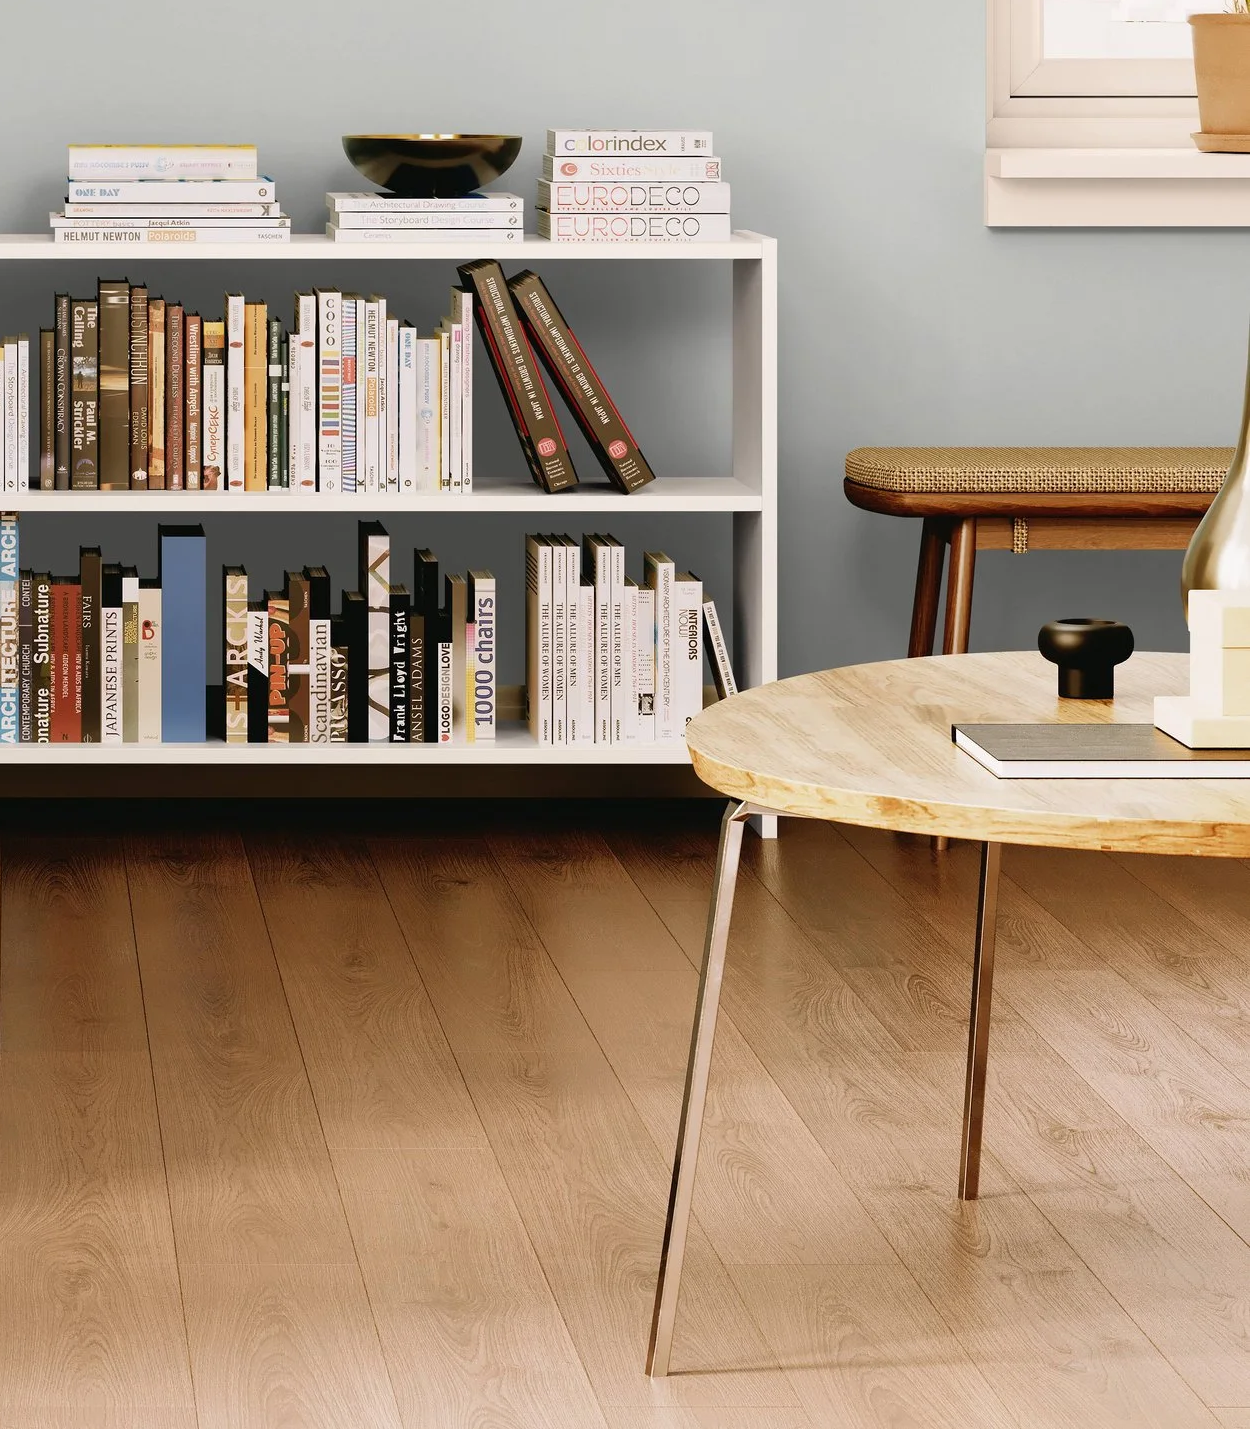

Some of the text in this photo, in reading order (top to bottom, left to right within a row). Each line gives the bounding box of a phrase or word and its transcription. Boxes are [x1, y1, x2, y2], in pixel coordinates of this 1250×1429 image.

[564, 136, 667, 152] colorindex
[590, 163, 641, 176] Sixties
[99, 189, 121, 197] DAY
[369, 201, 456, 211] Architectural Drawing
[557, 187, 700, 206] EURODECO
[63, 232, 141, 242] HELMUT NEWTON
[148, 230, 196, 241] Polaroids
[379, 216, 430, 227] Storyboard
[557, 217, 700, 237] EURODECO
[72, 306, 84, 348] Calling
[368, 309, 376, 372] HELMUT NEWTON
[485, 276, 544, 421] STRUCTURAL IMPEDIMENTS TO GROWTH IN JAPAN
[187, 323, 198, 416] Wrestling with Angels
[529, 291, 611, 426] STRUCTURAL IMPEDIMENTS TO GROWTH IN JAPAN
[6, 376, 15, 417] Storyboard
[56, 348, 65, 433] CROWN CONSPIRACY
[368, 377, 377, 417] Polaroids
[74, 400, 84, 451] Strickler
[87, 401, 96, 444] Paul M.
[33, 584, 50, 664] Subnature
[83, 595, 92, 629] FAIRS
[678, 608, 689, 638] NOW!
[254, 615, 264, 669] Andy Warhol
[556, 602, 564, 701] THE ALLURE OF WOMEN
[600, 602, 608, 701] THE ALLURE OF WOMEN
[688, 609, 698, 661] INTERIORS
[0, 587, 17, 743] ARCHITECTURE
[105, 611, 121, 737] JAPANESE PRINTS
[269, 623, 287, 706] PIN-UP
[393, 661, 407, 698] Lloyd
[475, 597, 493, 727] 1000 chairs
[542, 655, 549, 667] OF
[570, 655, 577, 667] OF
[614, 655, 621, 667] OF
[22, 644, 31, 740] CONTEMPORARY CHURCH
[310, 624, 329, 743] Scandinavian
[330, 652, 347, 743] PICASSO
[411, 638, 423, 742] ANSEL ADAMS
[393, 704, 407, 741] Frank
